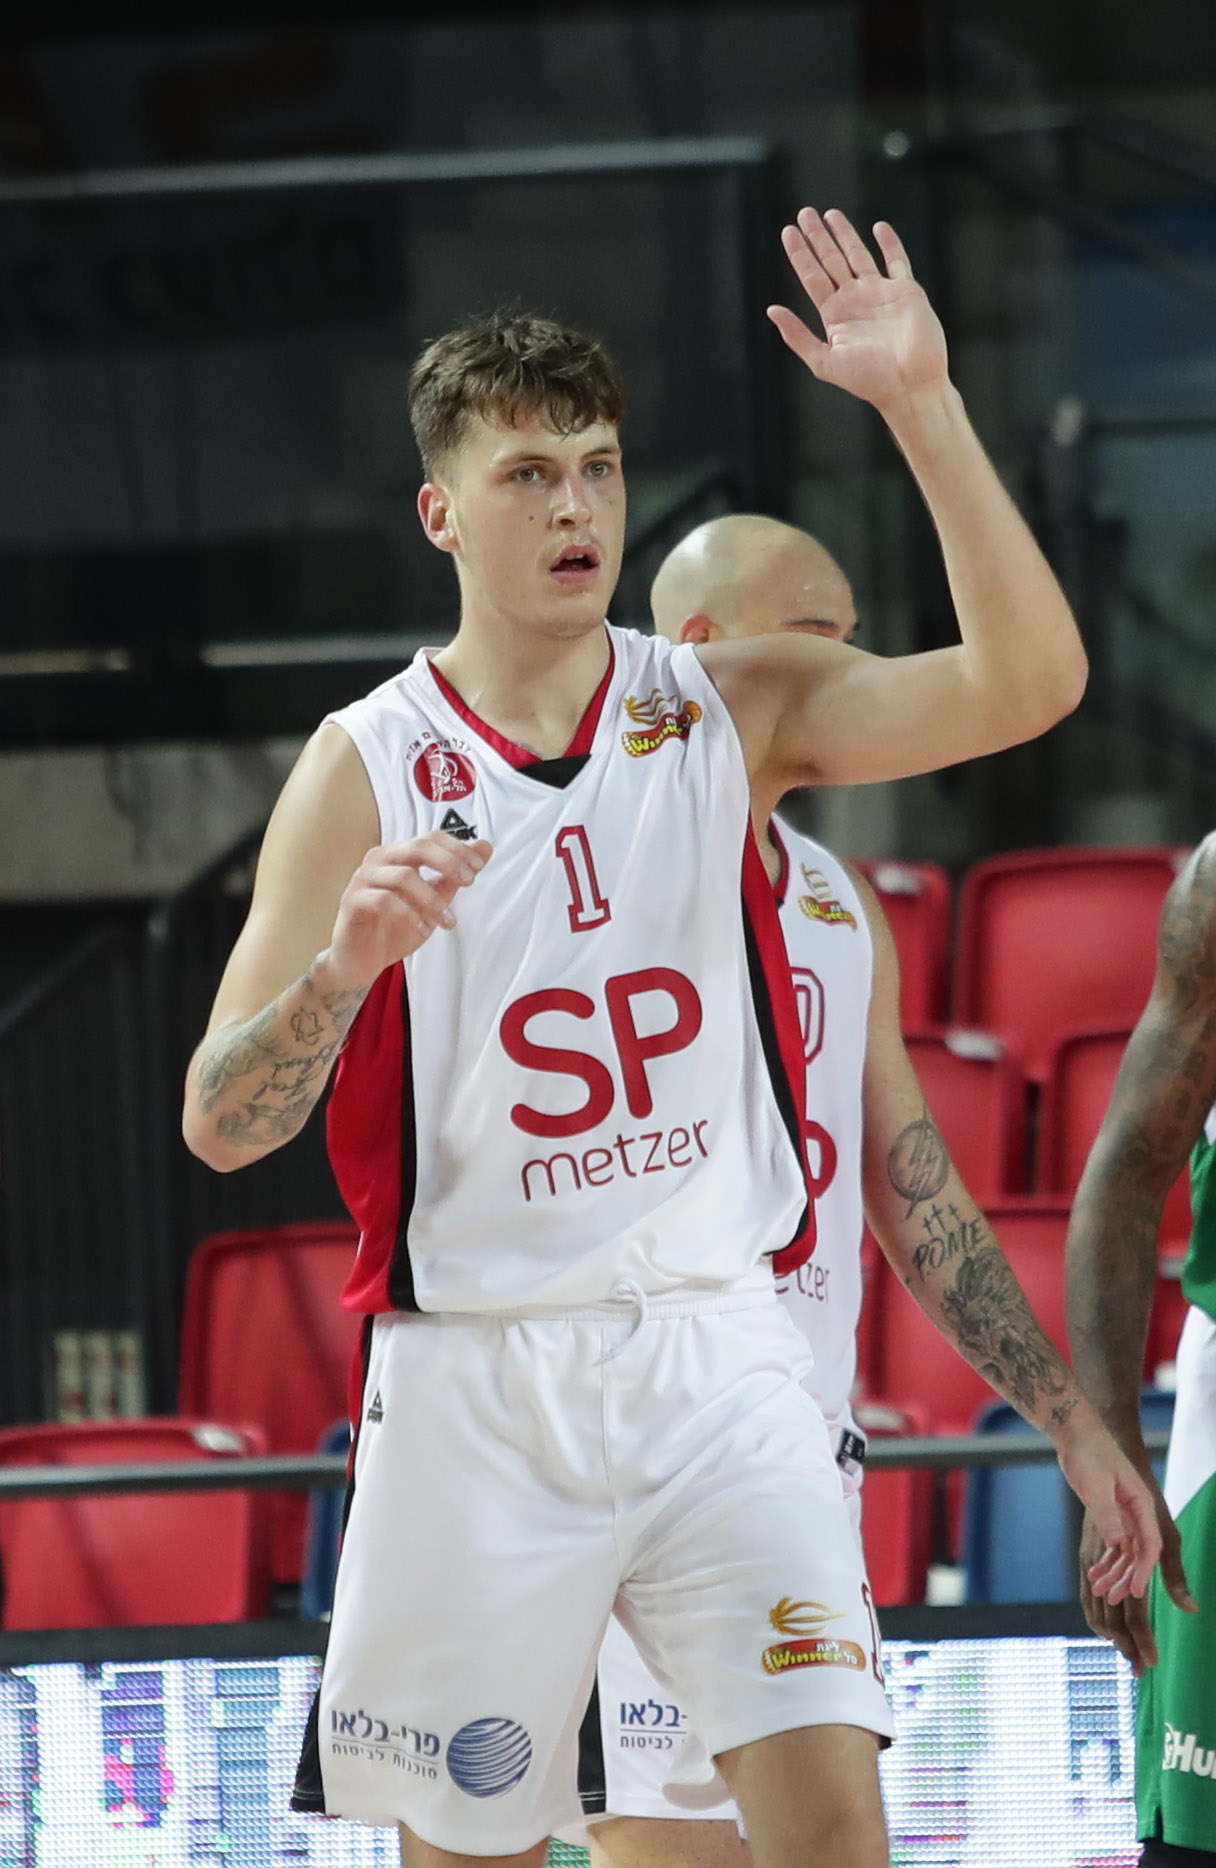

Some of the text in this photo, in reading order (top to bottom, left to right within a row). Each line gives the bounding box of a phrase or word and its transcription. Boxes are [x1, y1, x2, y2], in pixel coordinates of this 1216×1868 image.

[555, 825, 611, 934] 1
[499, 966, 702, 1138] SP
[520, 1117, 710, 1202] metzer
[771, 1648, 842, 1669] Winner
[331, 1709, 441, 1758] פרי-בלאו
